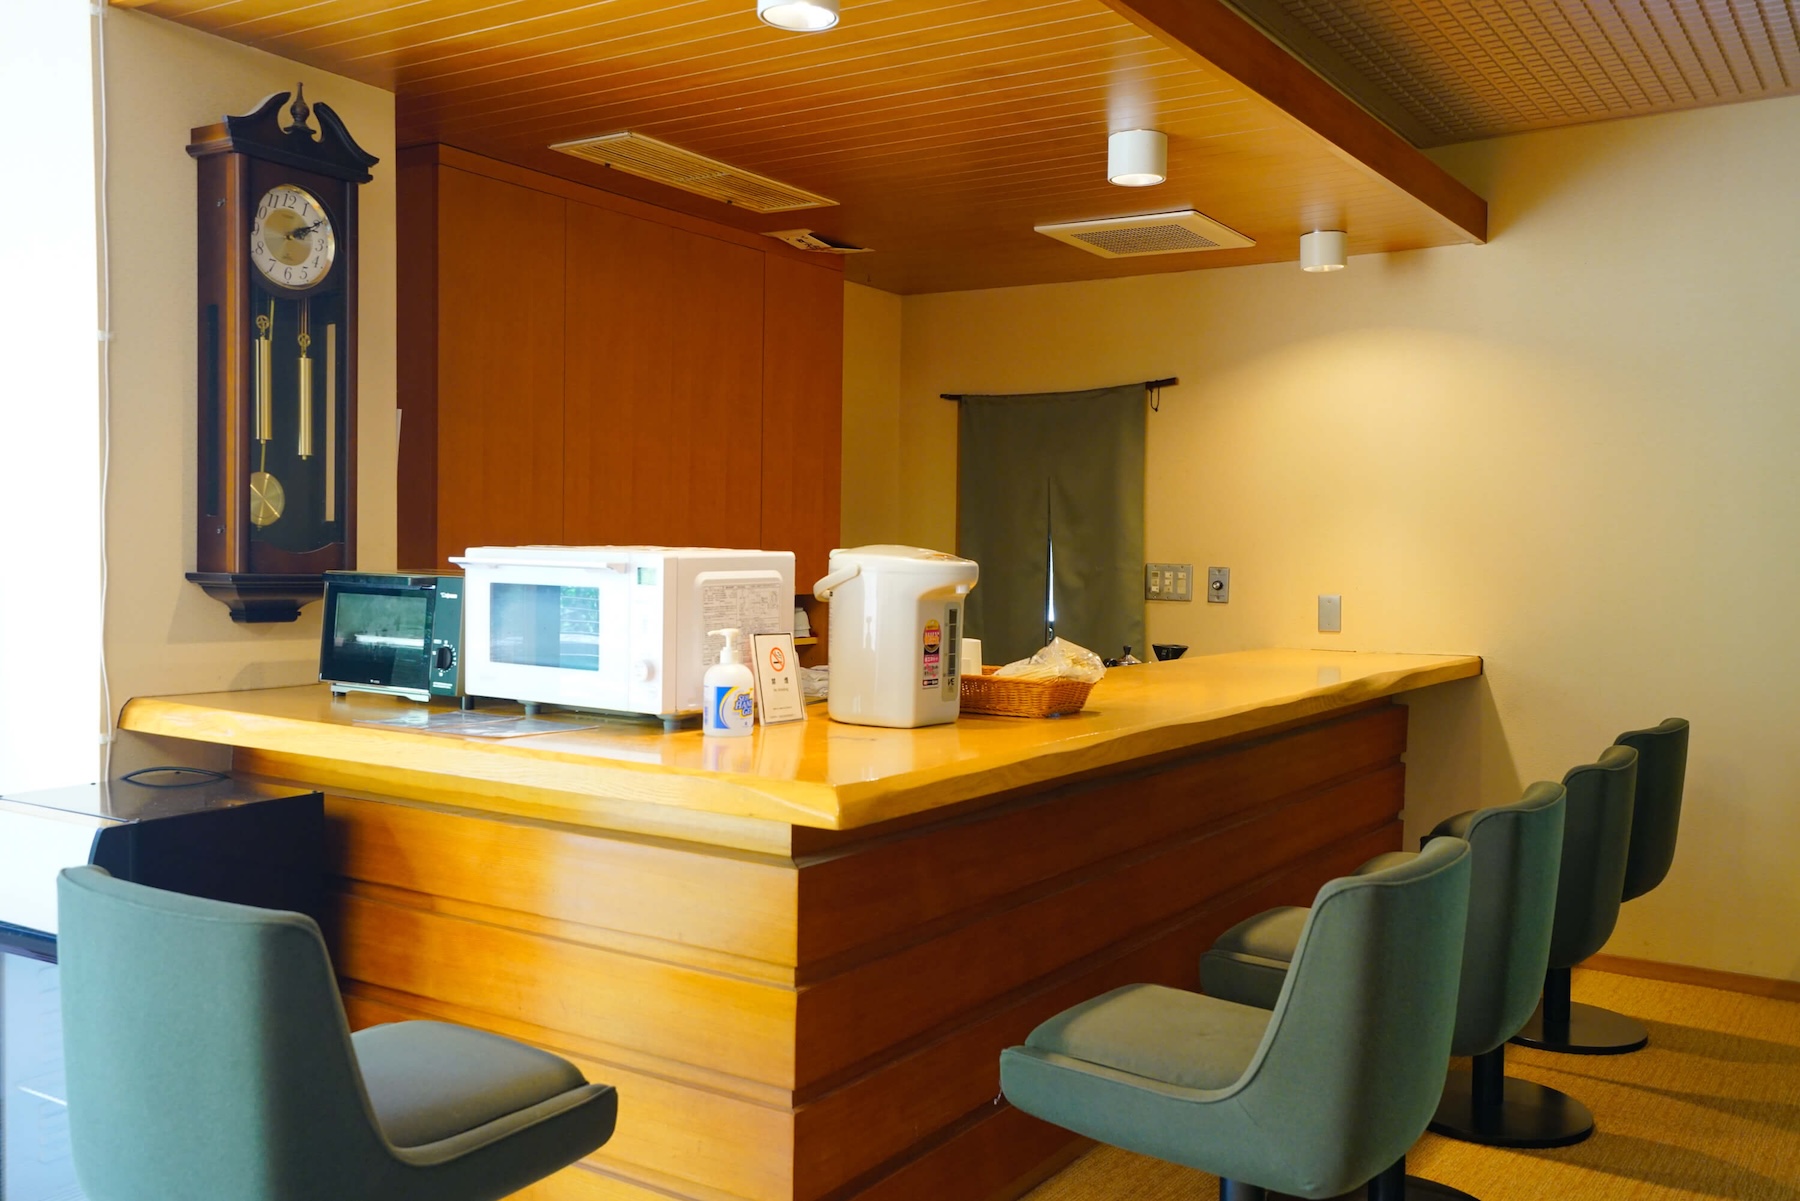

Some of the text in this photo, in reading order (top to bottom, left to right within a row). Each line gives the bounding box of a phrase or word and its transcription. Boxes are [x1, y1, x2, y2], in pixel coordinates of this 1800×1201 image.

[268, 194, 280, 208] 11
[282, 194, 297, 209] 12
[302, 202, 310, 216] 1
[255, 241, 264, 255] 8
[315, 239, 324, 252] 3
[269, 258, 276, 272] 7
[312, 256, 319, 268] 4
[284, 266, 292, 280] 6
[299, 266, 308, 280] 5
